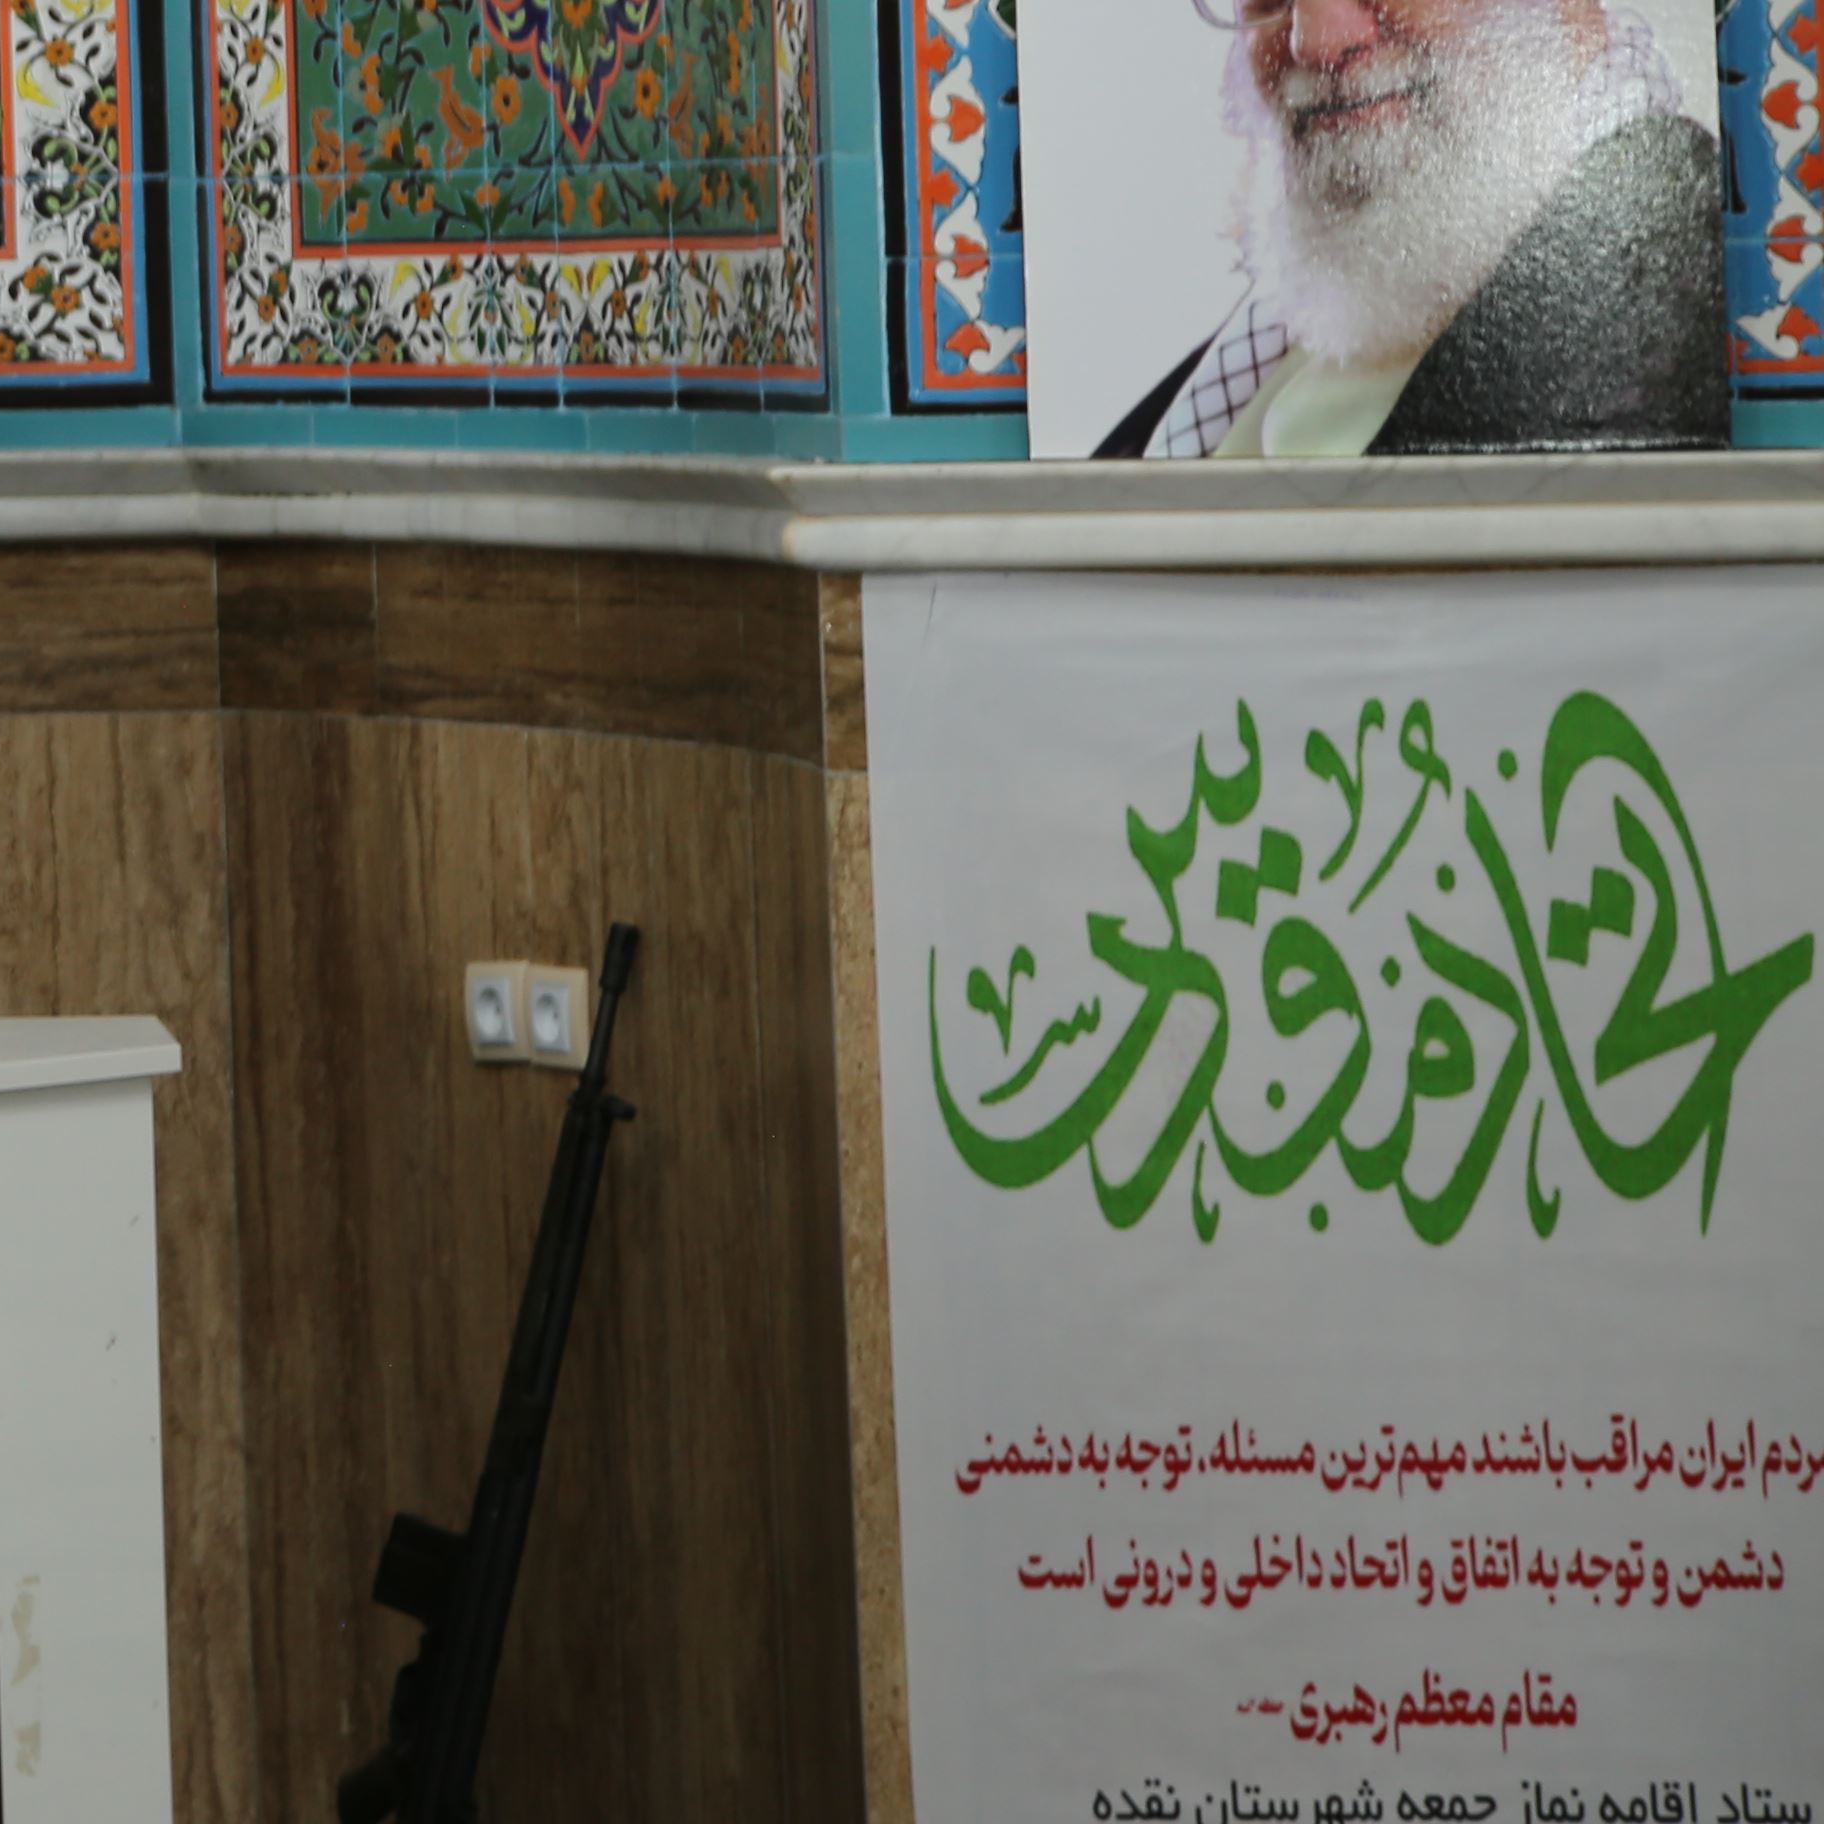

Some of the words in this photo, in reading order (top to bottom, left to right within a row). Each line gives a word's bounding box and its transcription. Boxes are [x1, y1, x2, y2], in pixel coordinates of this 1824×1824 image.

[953, 1423, 1075, 1497] دشمنی
[1076, 1433, 1111, 1490] به
[1113, 1423, 1195, 1494] توجه
[1471, 1419, 1569, 1490] باشند
[1569, 1412, 1675, 1493] مراقب
[1678, 1418, 1758, 1493] ایران
[1016, 1535, 1098, 1592] است
[1102, 1539, 1194, 1613] درونی
[1199, 1557, 1221, 1609] و
[1223, 1534, 1326, 1612] داخلی
[1327, 1535, 1411, 1592] اتحاد
[1416, 1557, 1436, 1609] و
[1440, 1535, 1522, 1608] اتفاق
[1525, 1550, 1561, 1606] به
[1564, 1538, 1647, 1610] توجه
[1649, 1558, 1672, 1609] و
[1675, 1540, 1786, 1610] دشمن
[1289, 1682, 1391, 1747] رهبری
[1393, 1669, 1498, 1749] معظم
[1500, 1670, 1580, 1751] مقام
[1092, 1778, 1182, 1822] نقده
[1520, 1779, 1586, 1824] نماز
[1598, 1781, 1699, 1824] اقامه
[1716, 1781, 1813, 1824] ستاد
